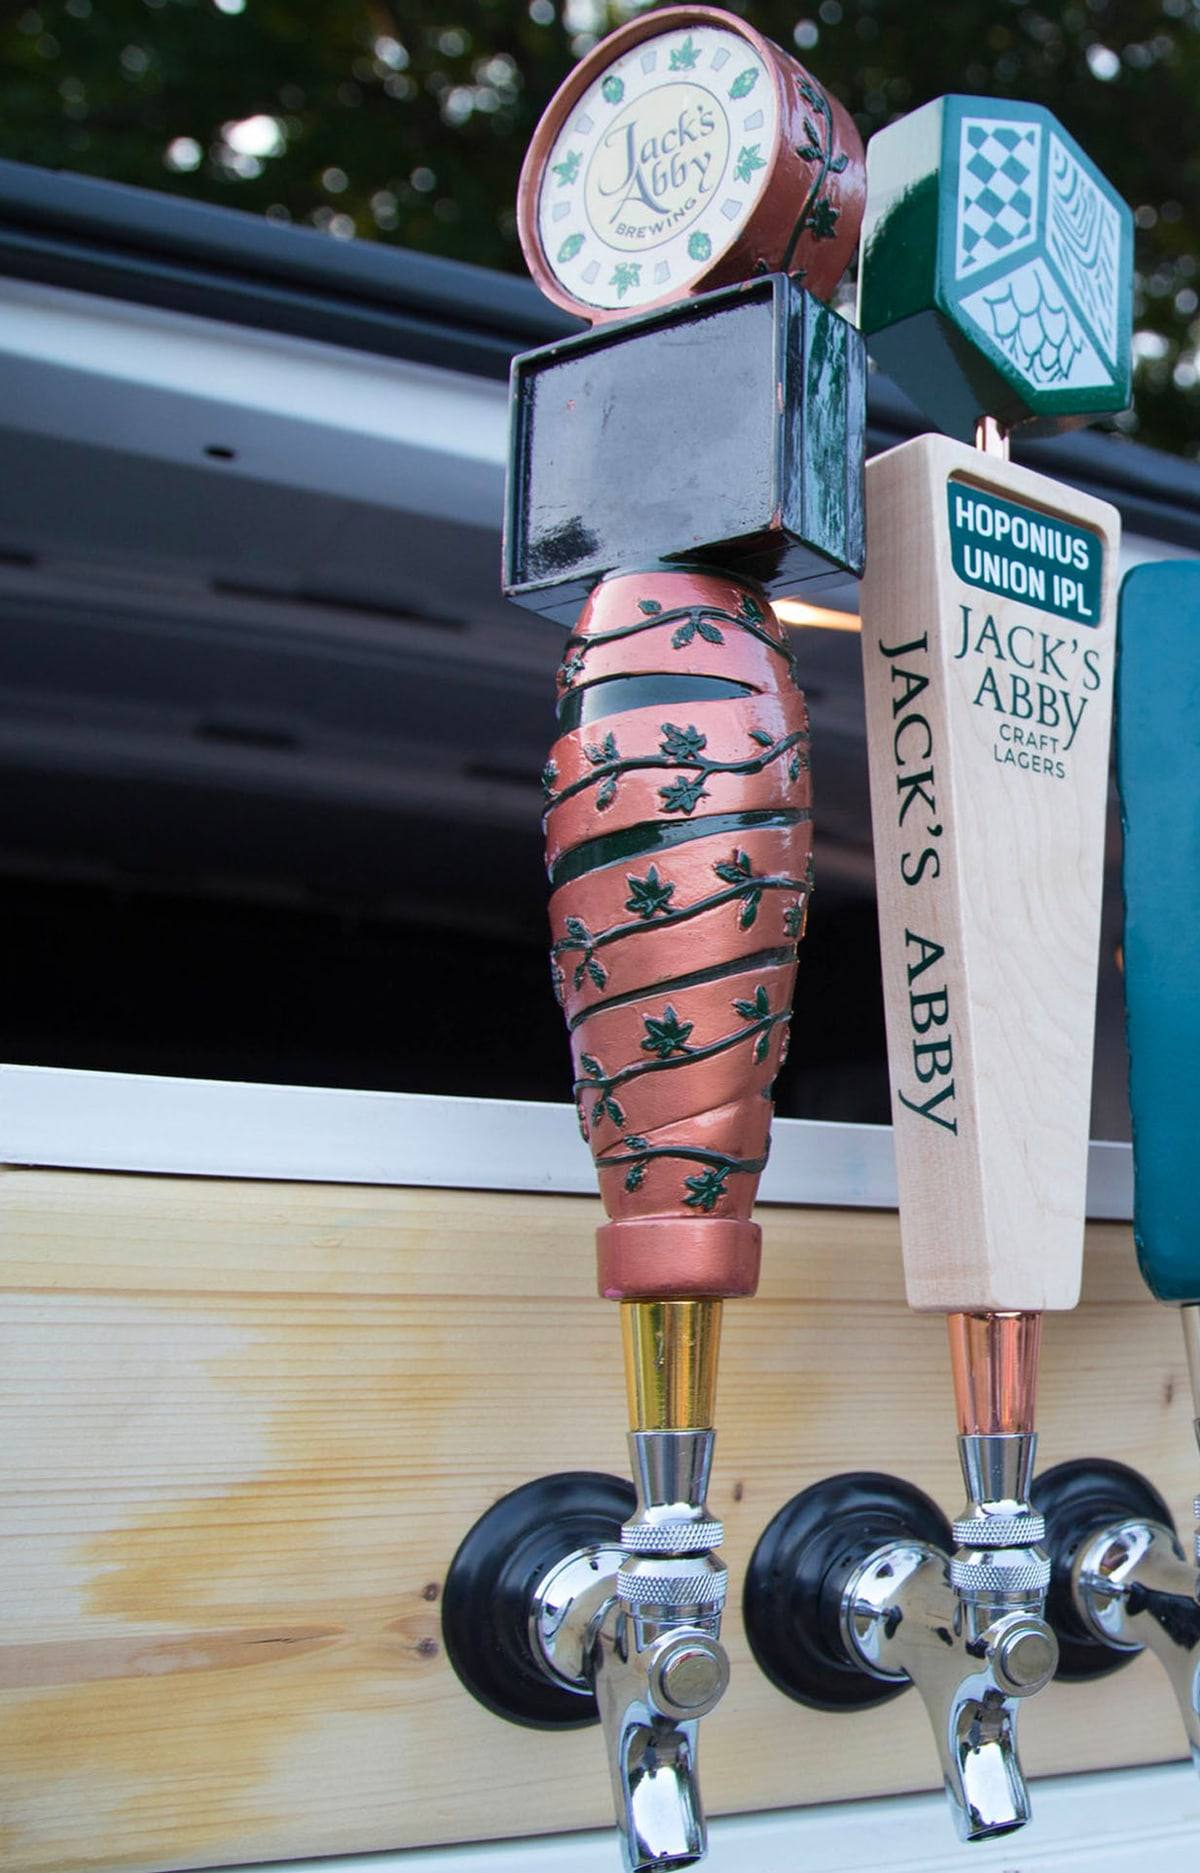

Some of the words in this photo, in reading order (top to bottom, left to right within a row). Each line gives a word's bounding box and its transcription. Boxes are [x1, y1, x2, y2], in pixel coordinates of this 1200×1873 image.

[598, 105, 715, 196] Jack's
[609, 151, 712, 225] Abby
[616, 197, 697, 238] BREWING
[955, 496, 1090, 570] HOPONIUS
[964, 545, 1045, 601] UNION
[1054, 575, 1092, 616] IPL
[955, 605, 1101, 691] JACK'S
[973, 667, 1088, 751] ABBY
[999, 723, 1059, 753] CRAFT
[879, 630, 943, 886] JACK'S
[994, 744, 1065, 778] LAGERS
[899, 928, 958, 1137] ABBY
